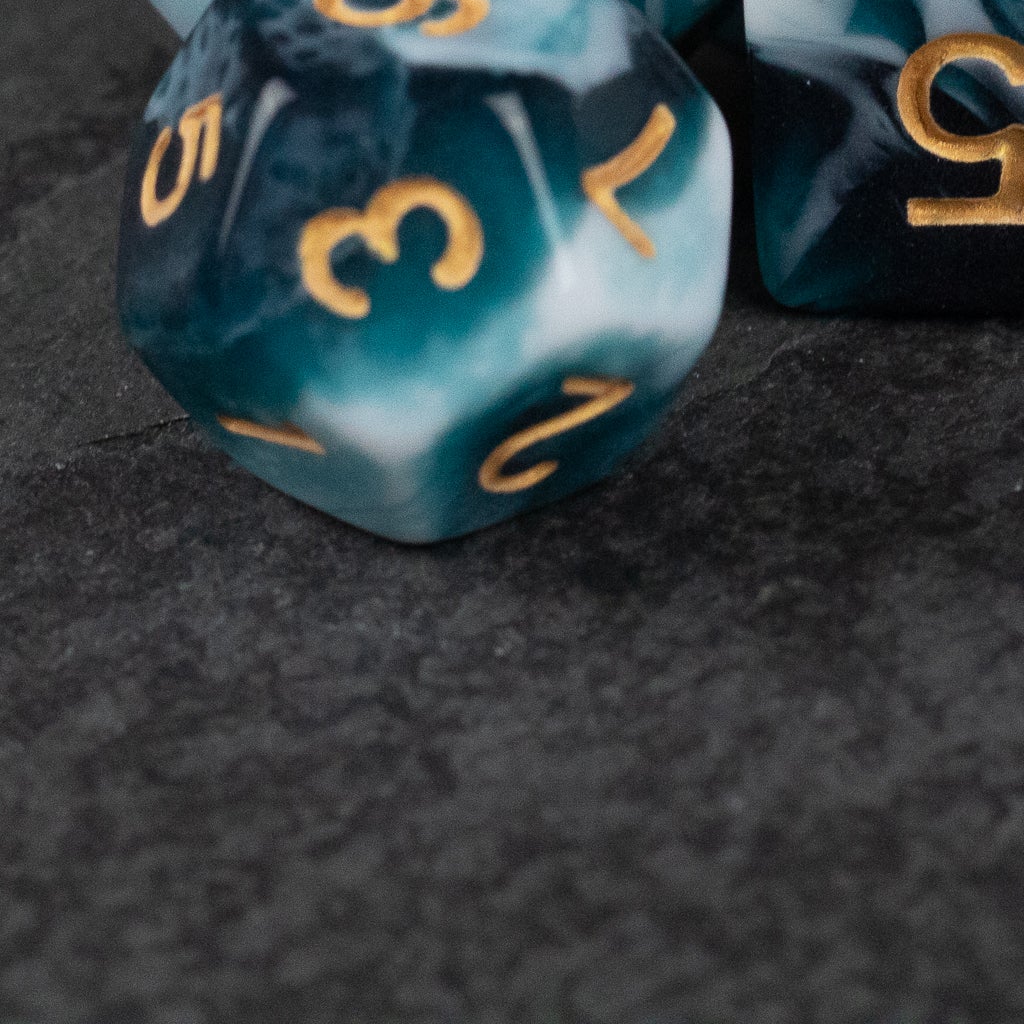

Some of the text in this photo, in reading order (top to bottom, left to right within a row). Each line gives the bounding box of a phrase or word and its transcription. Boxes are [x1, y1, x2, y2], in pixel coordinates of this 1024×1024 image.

[139, 93, 223, 227] 5
[582, 103, 676, 258] 7
[298, 178, 483, 318] 3
[478, 377, 633, 493] 2
